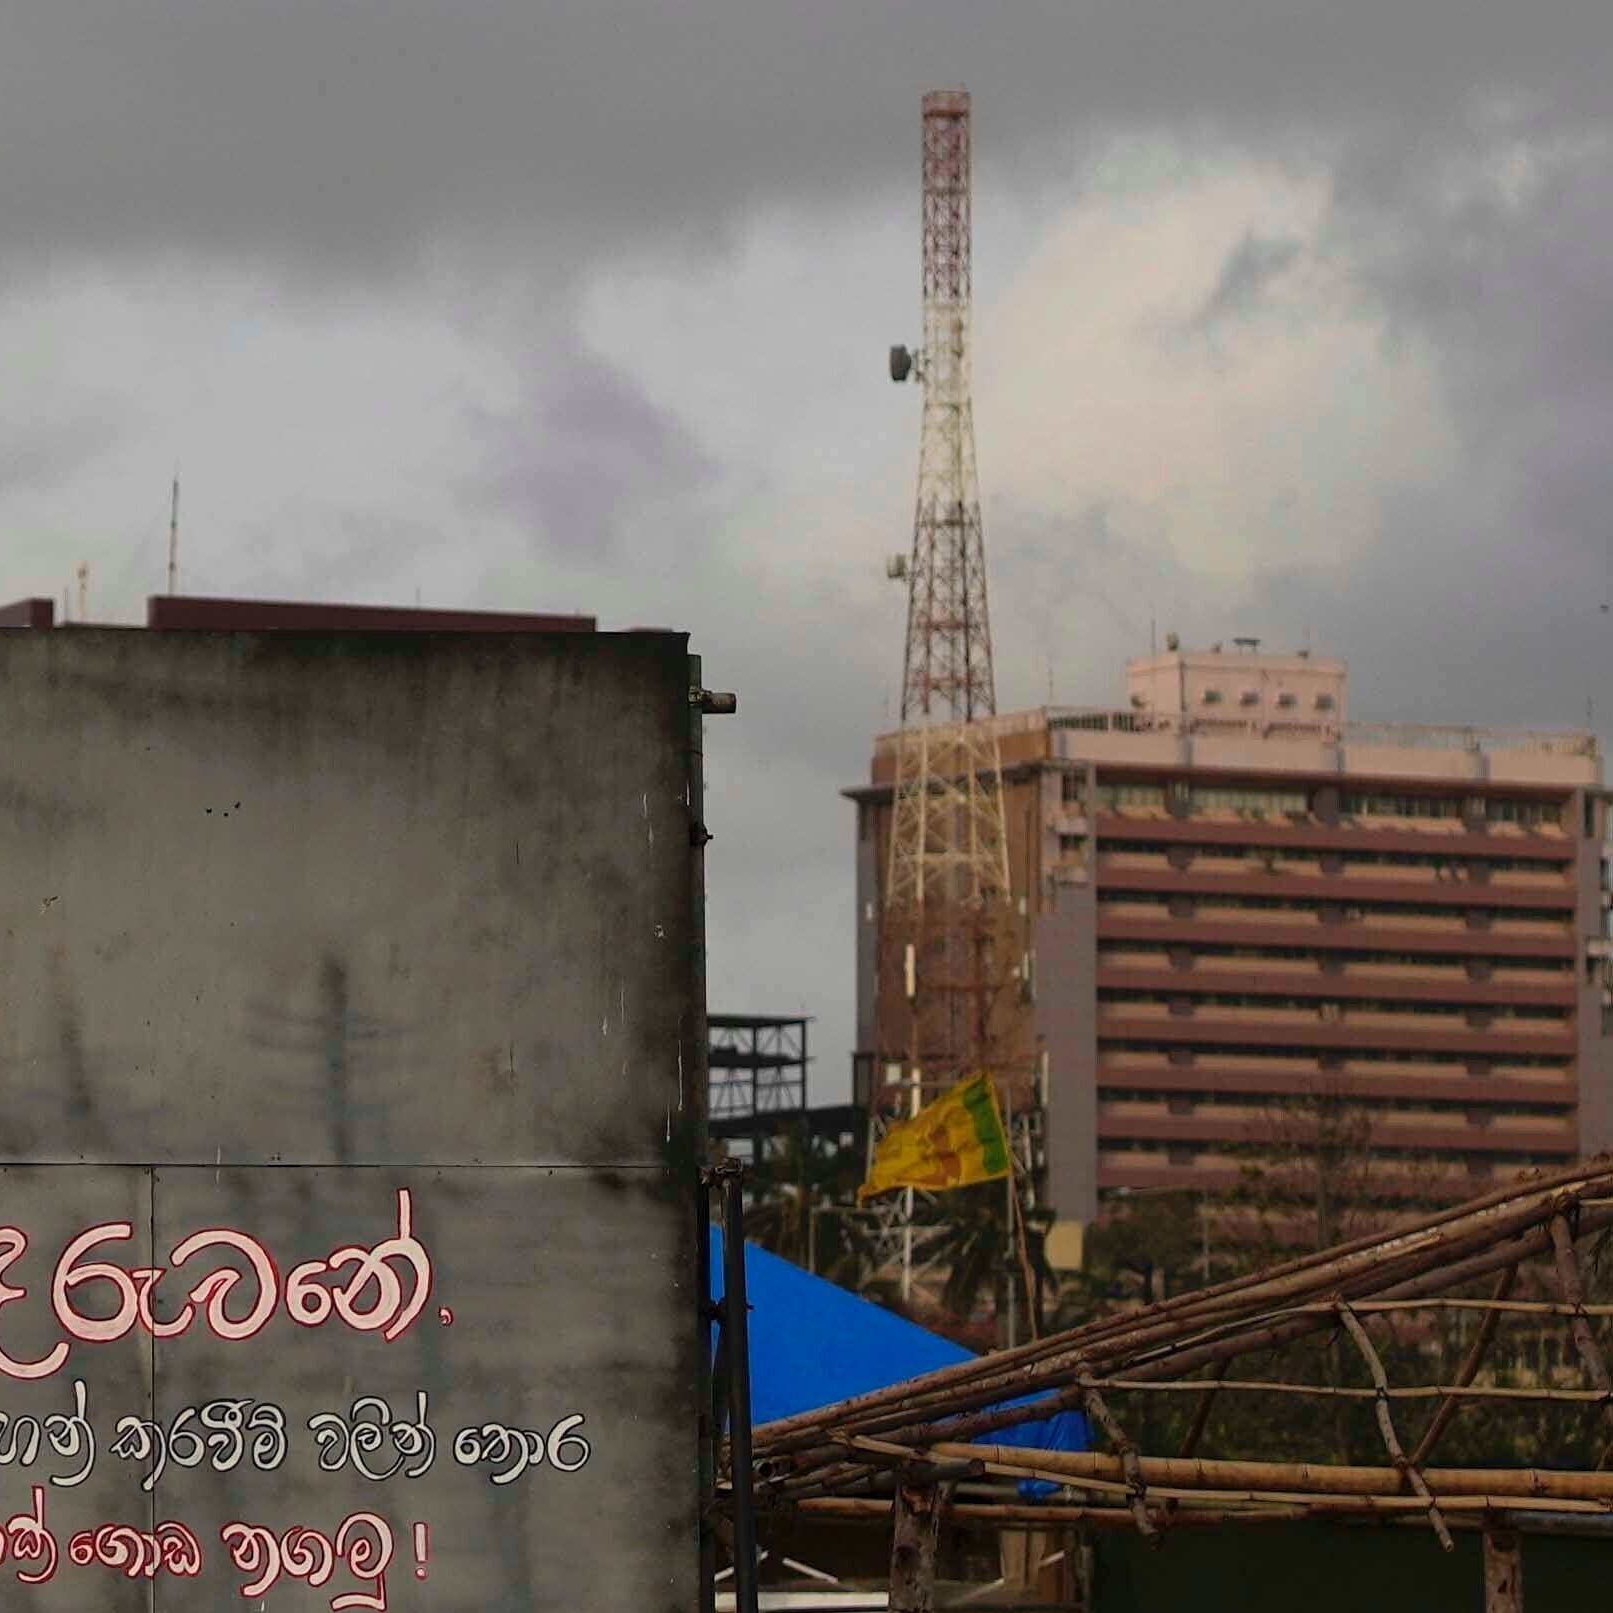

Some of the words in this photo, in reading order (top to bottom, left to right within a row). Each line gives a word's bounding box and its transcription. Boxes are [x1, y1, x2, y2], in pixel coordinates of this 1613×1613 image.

[307, 1391, 437, 1482] වලින්
[450, 1415, 592, 1486] තොර
[70, 1518, 202, 1580] ගොඩ
